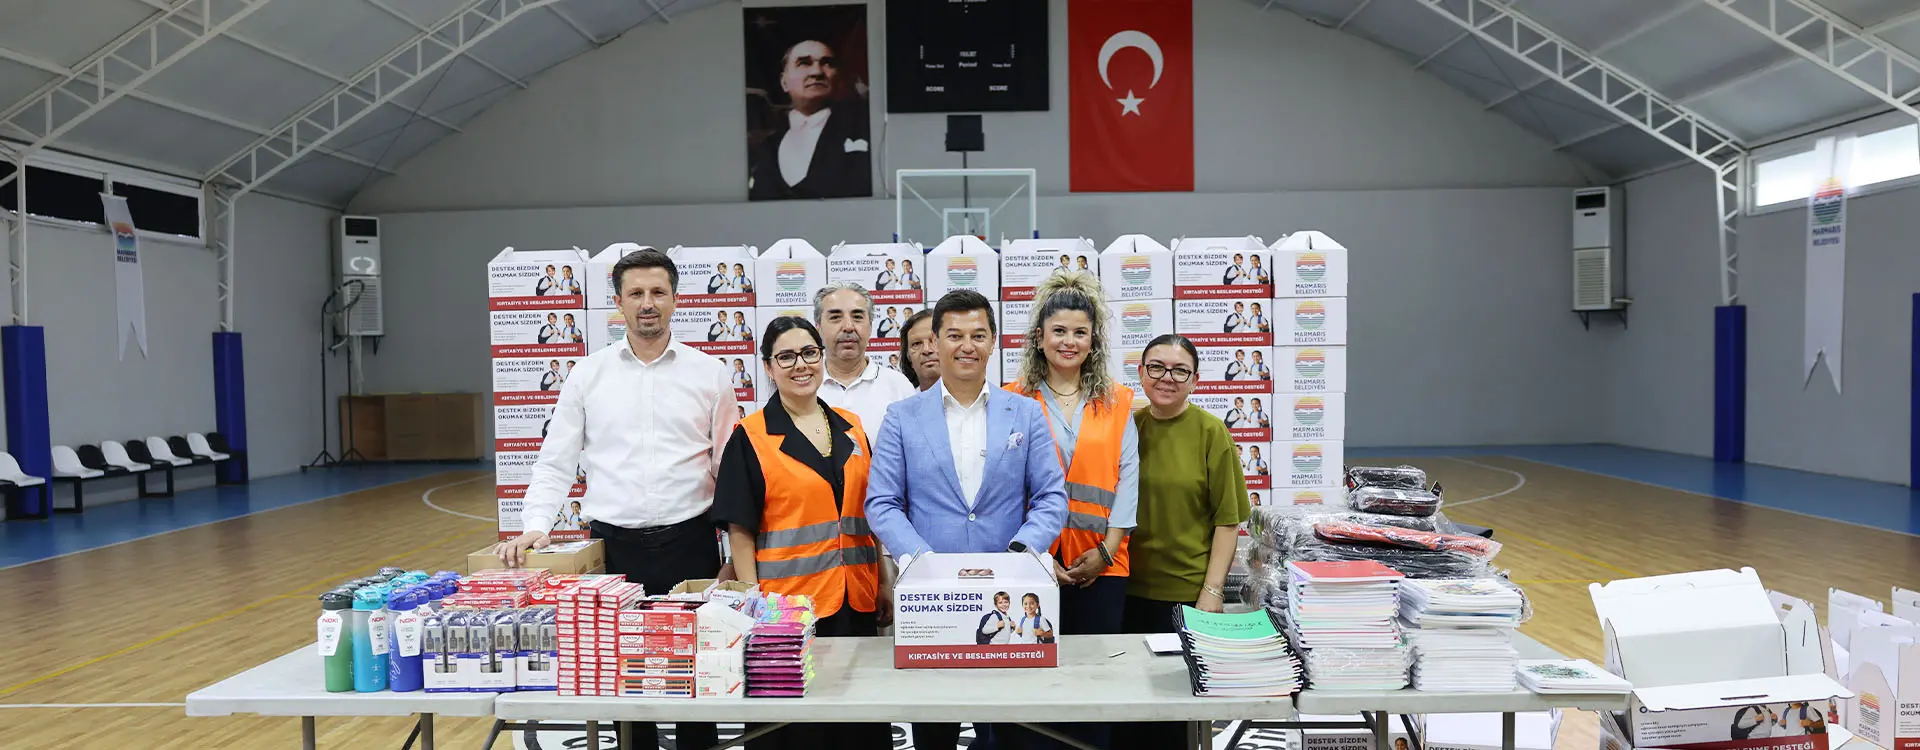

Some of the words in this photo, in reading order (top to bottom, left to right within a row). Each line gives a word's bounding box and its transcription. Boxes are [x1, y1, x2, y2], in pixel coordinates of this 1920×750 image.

[900, 594, 940, 602] DESTEK
[943, 592, 983, 600] BİZDEN
[900, 604, 944, 612] OKUMAK
[946, 603, 983, 612] SİZDEN
[908, 652, 950, 660] KIRTASİYE
[1010, 650, 1045, 659] DESTEĞİ
